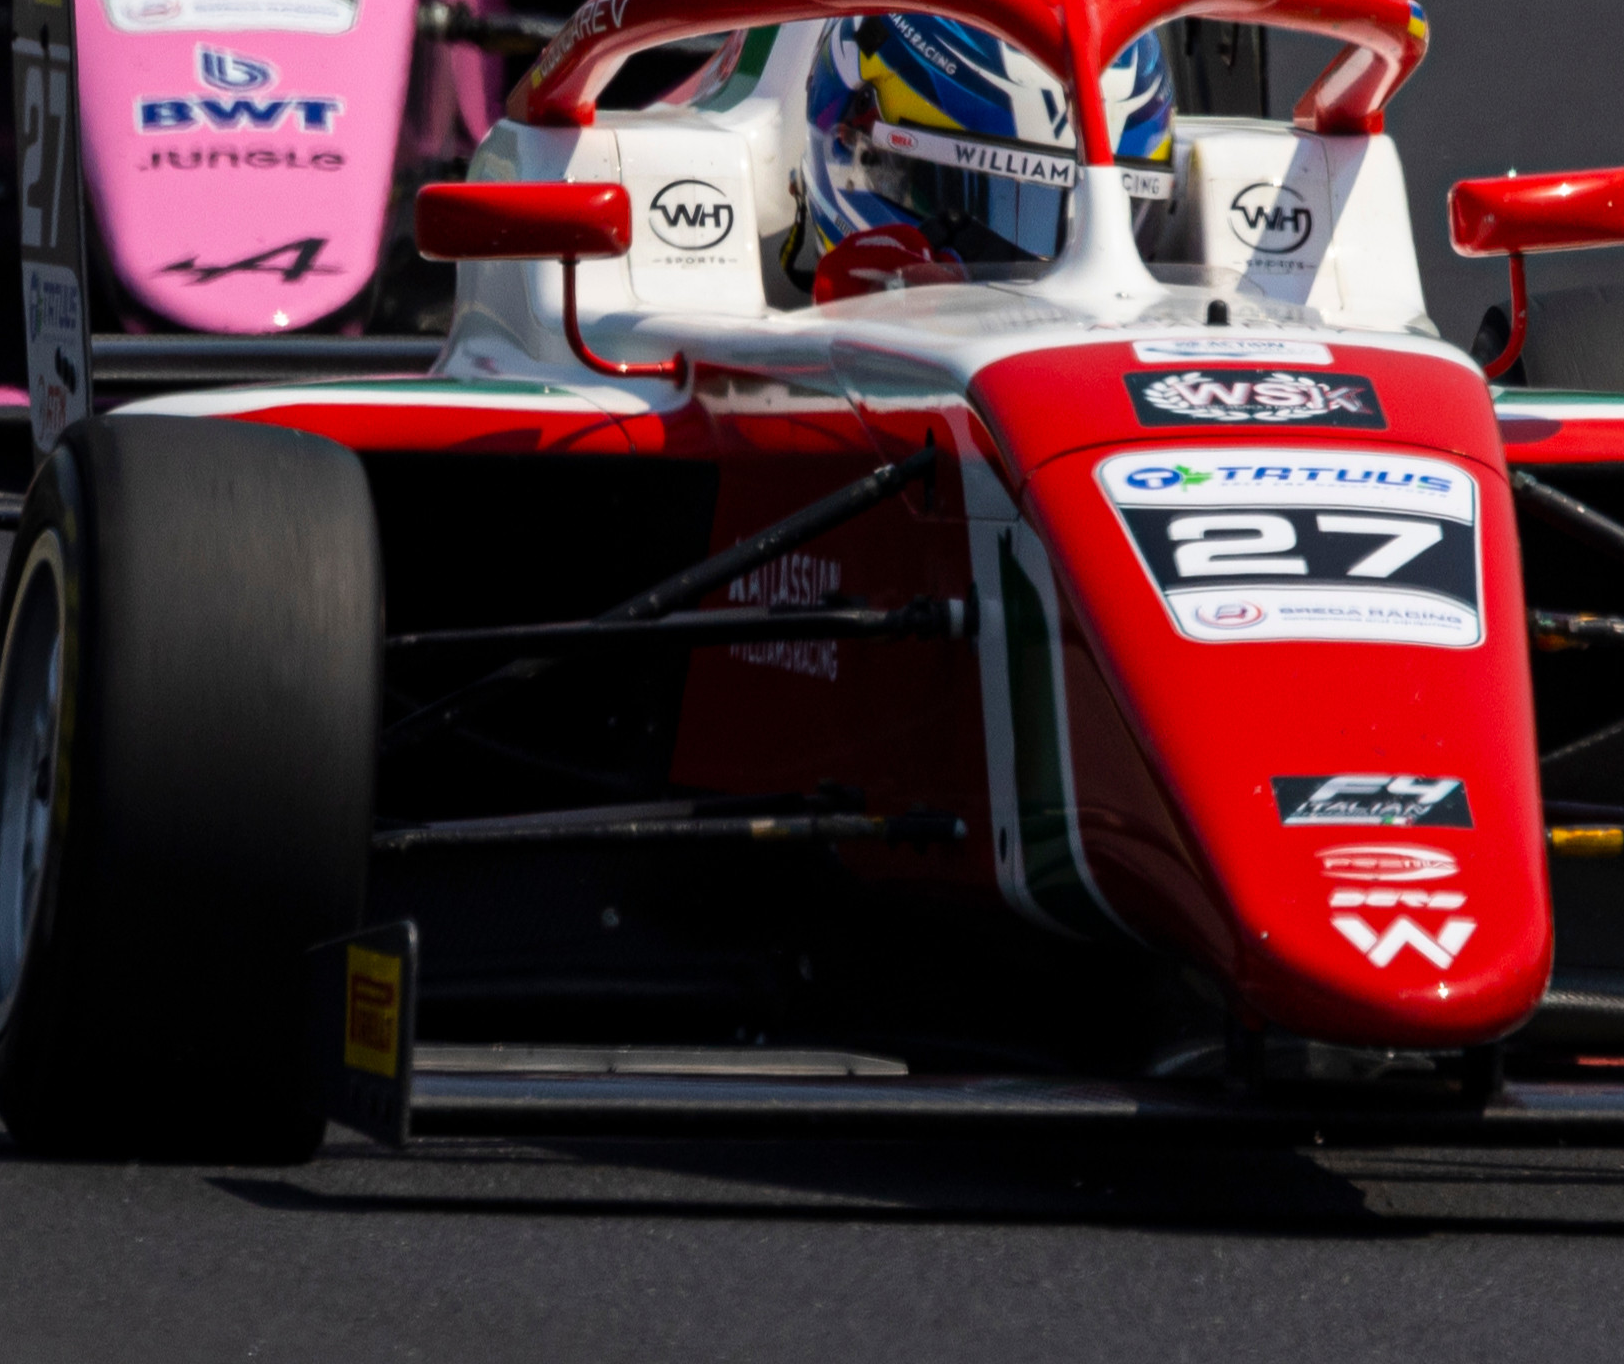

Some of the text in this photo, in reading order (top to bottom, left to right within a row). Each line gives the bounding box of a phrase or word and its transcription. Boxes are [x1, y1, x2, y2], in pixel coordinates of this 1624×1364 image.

[138, 100, 342, 133] BWT
[1217, 466, 1453, 493] TATUUS
[1167, 513, 1444, 578] 27
[1308, 775, 1462, 805] F4
